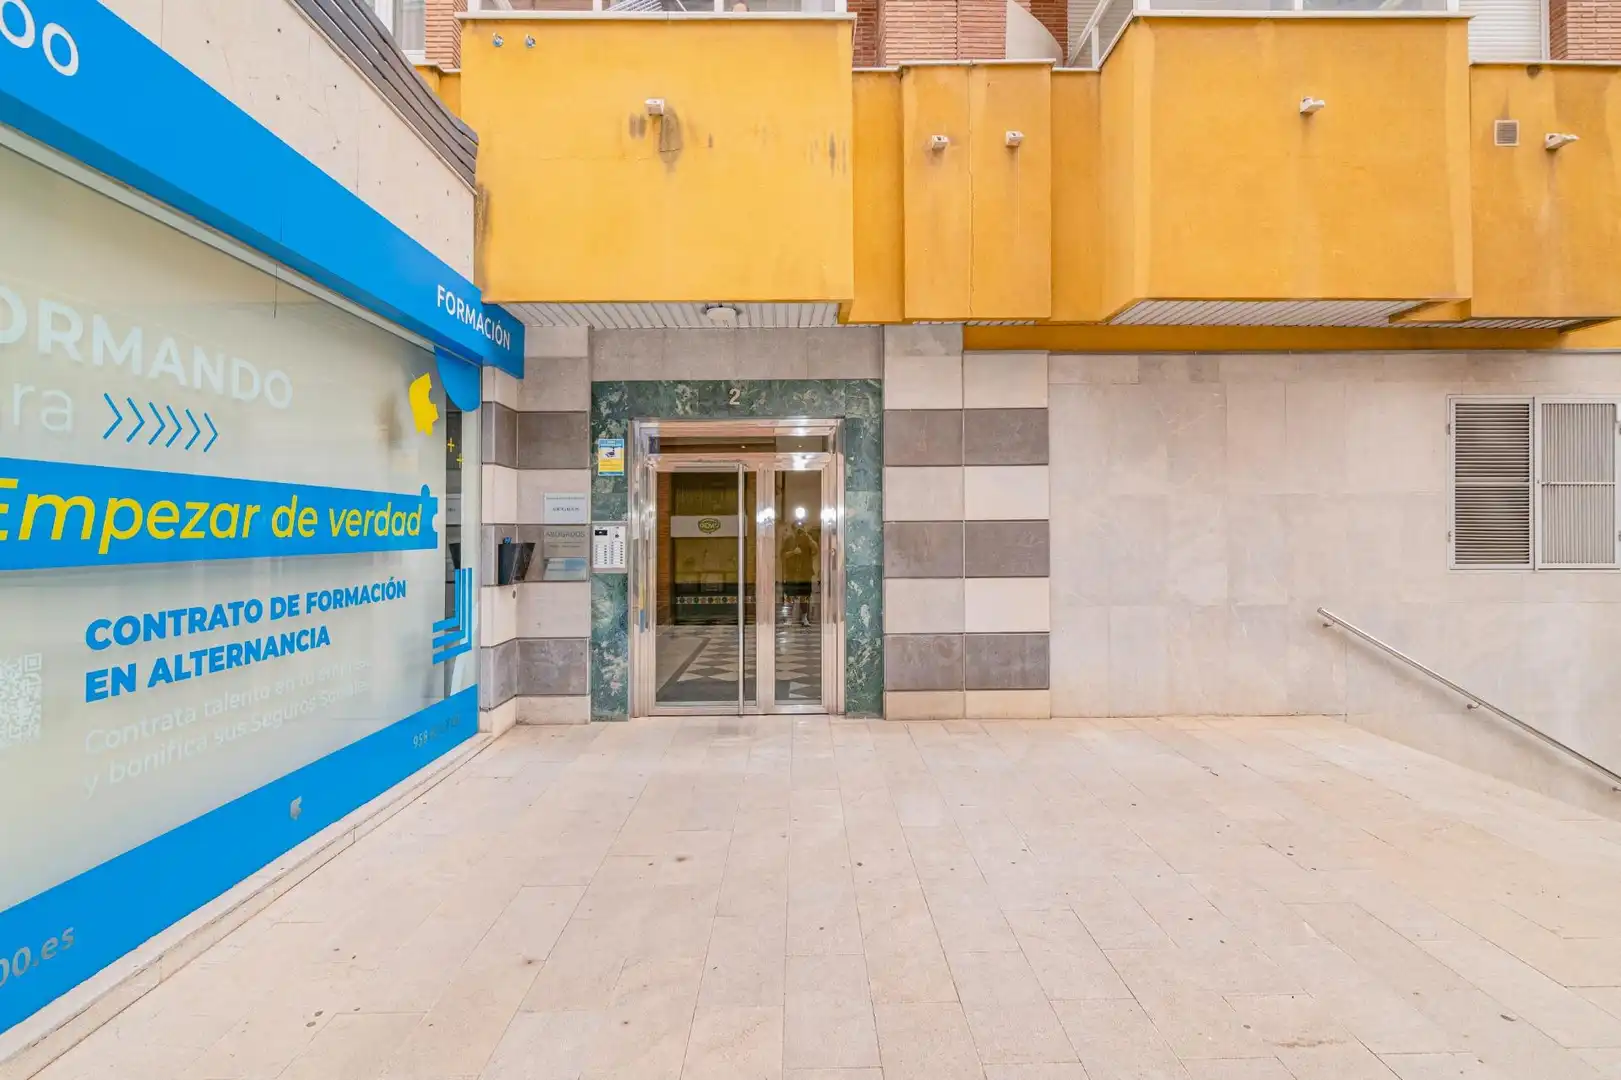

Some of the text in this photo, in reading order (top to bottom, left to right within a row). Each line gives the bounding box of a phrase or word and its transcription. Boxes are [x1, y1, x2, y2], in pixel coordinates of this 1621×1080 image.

[437, 284, 511, 351] FORMACIÓN
[729, 387, 741, 405] 2
[271, 494, 318, 539] de
[328, 501, 423, 538] verdad
[85, 576, 406, 651] CONTRATO DE FORMACIÓN
[85, 625, 330, 703] EN ALTERNANCIA
[82, 771, 100, 800] y
[108, 735, 208, 785] bonifica
[215, 720, 247, 745] sus
[250, 695, 317, 732] Seguros
[84, 706, 196, 755] Contrata
[204, 685, 271, 716] talento
[275, 677, 296, 695] en
